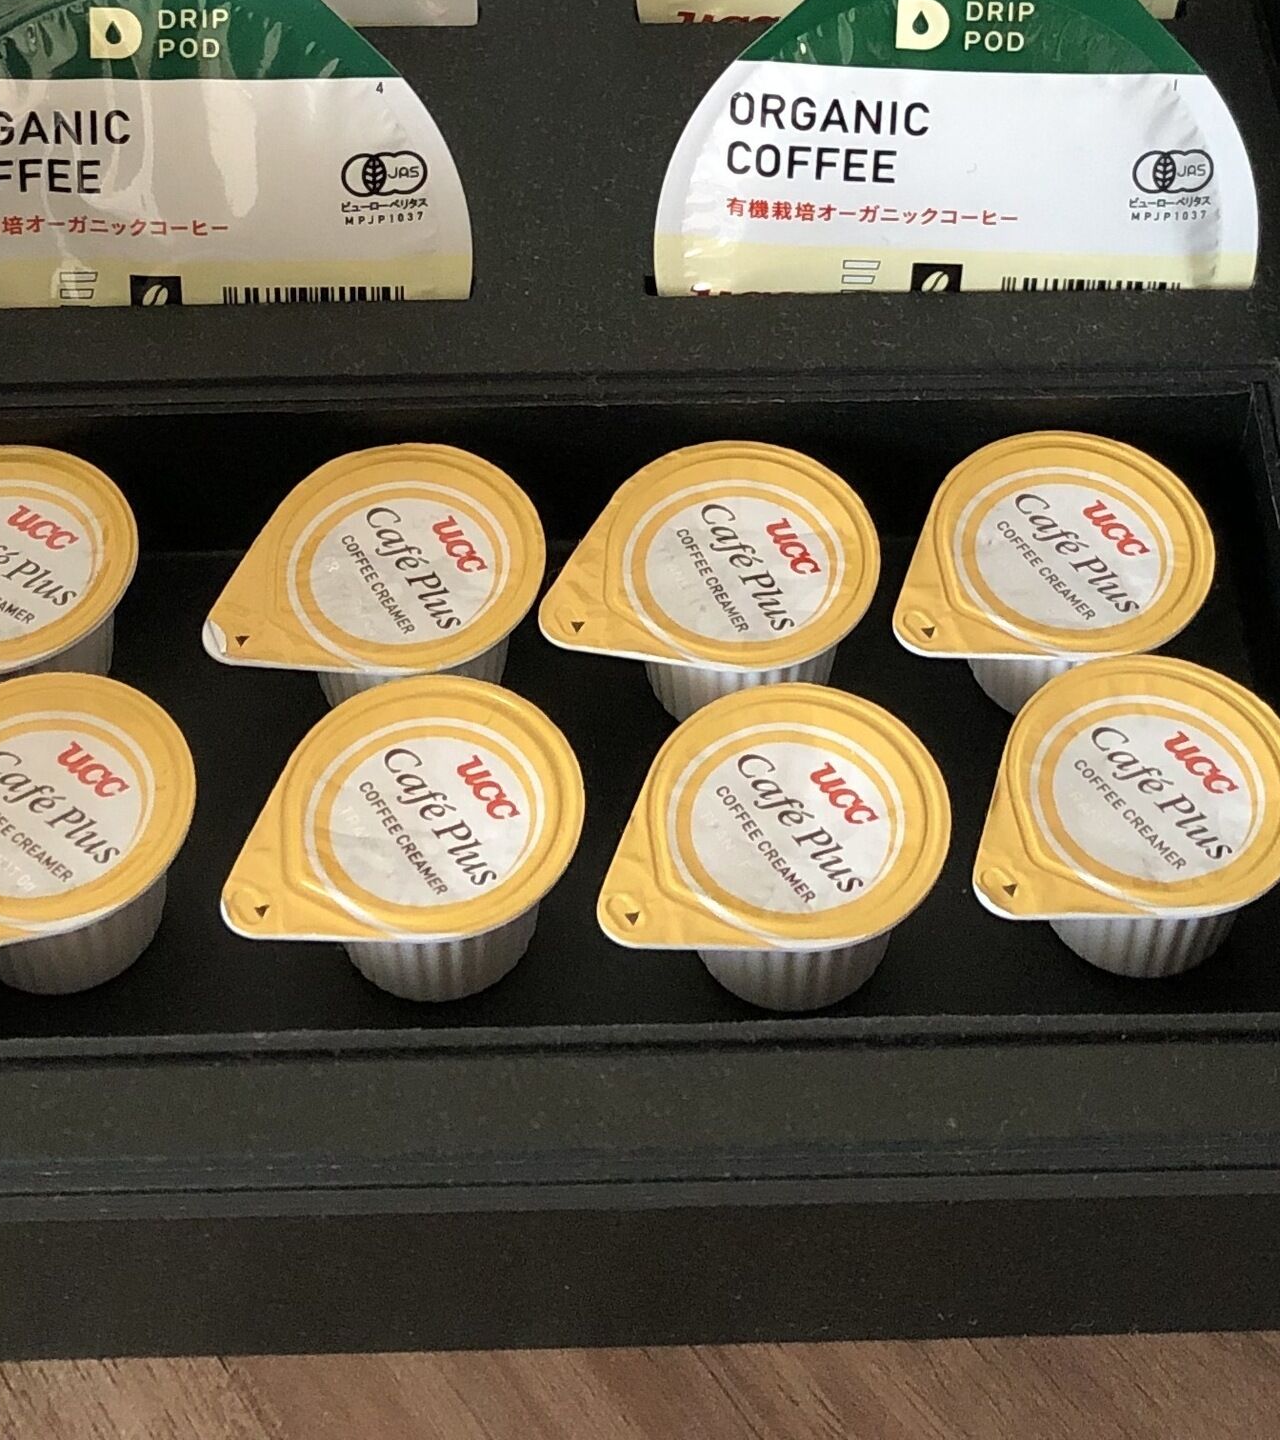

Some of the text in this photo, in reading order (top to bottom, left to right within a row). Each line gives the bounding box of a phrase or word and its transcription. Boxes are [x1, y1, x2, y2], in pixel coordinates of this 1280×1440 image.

[158, 9, 229, 28] DRIP
[966, 2, 1035, 22] DRIP
[158, 39, 221, 58] POD
[965, 32, 1025, 52] POD
[376, 82, 383, 94] 4
[729, 92, 930, 136] ORGANIC
[388, 167, 419, 179] JAS
[726, 141, 897, 184] COFFEE
[1177, 164, 1206, 177] JAS
[342, 198, 428, 212] ビューローベリタス
[345, 212, 423, 225] MPJP1037
[726, 198, 1018, 226] 有機栽培オーガニックコーヒー
[1129, 196, 1211, 208] ビューローベリタス
[1132, 211, 1206, 221] MPJP1037
[367, 507, 462, 630] Café Plus
[701, 504, 796, 631] Café Plus
[997, 520, 1096, 620] COFFEE CREAMER
[1015, 493, 1140, 614] Café Plus
[2, 558, 79, 607] Plus
[341, 535, 416, 635] COFFEE CREAMER
[676, 528, 749, 632] COFFEE CREAMER
[384, 748, 498, 887] Café Plus
[1074, 759, 1187, 870] COFFEE CREAMER
[1091, 727, 1233, 860] Café Plus
[45, 806, 121, 865] Plus
[359, 781, 448, 896] COFFEE CREAMER
[716, 786, 816, 903] COFFEE CREAMER
[737, 753, 864, 893] Café Plus
[11, 831, 74, 882] CREAMER
